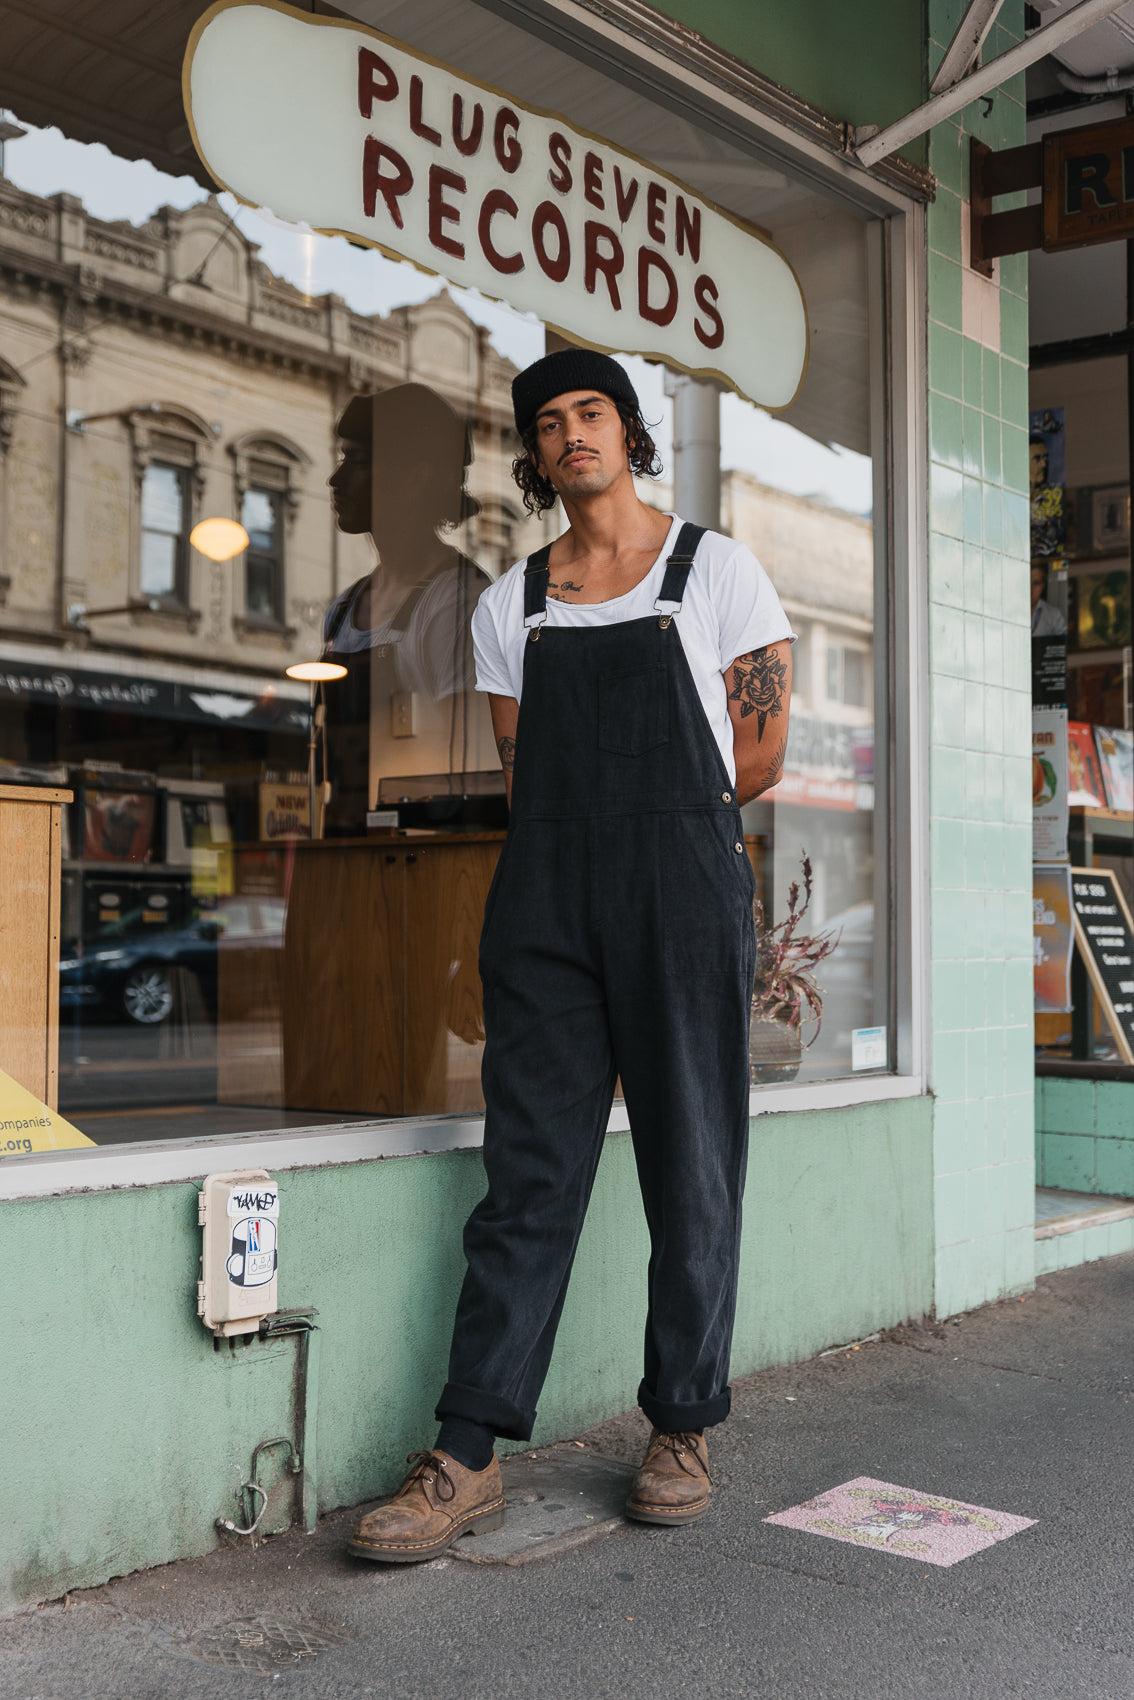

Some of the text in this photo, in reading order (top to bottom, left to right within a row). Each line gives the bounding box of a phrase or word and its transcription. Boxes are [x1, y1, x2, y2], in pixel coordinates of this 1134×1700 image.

[357, 46, 701, 265] PLUG SEVEN
[1064, 145, 1134, 216] R
[362, 135, 724, 350] RECORDS
[1042, 486, 1063, 509] 39
